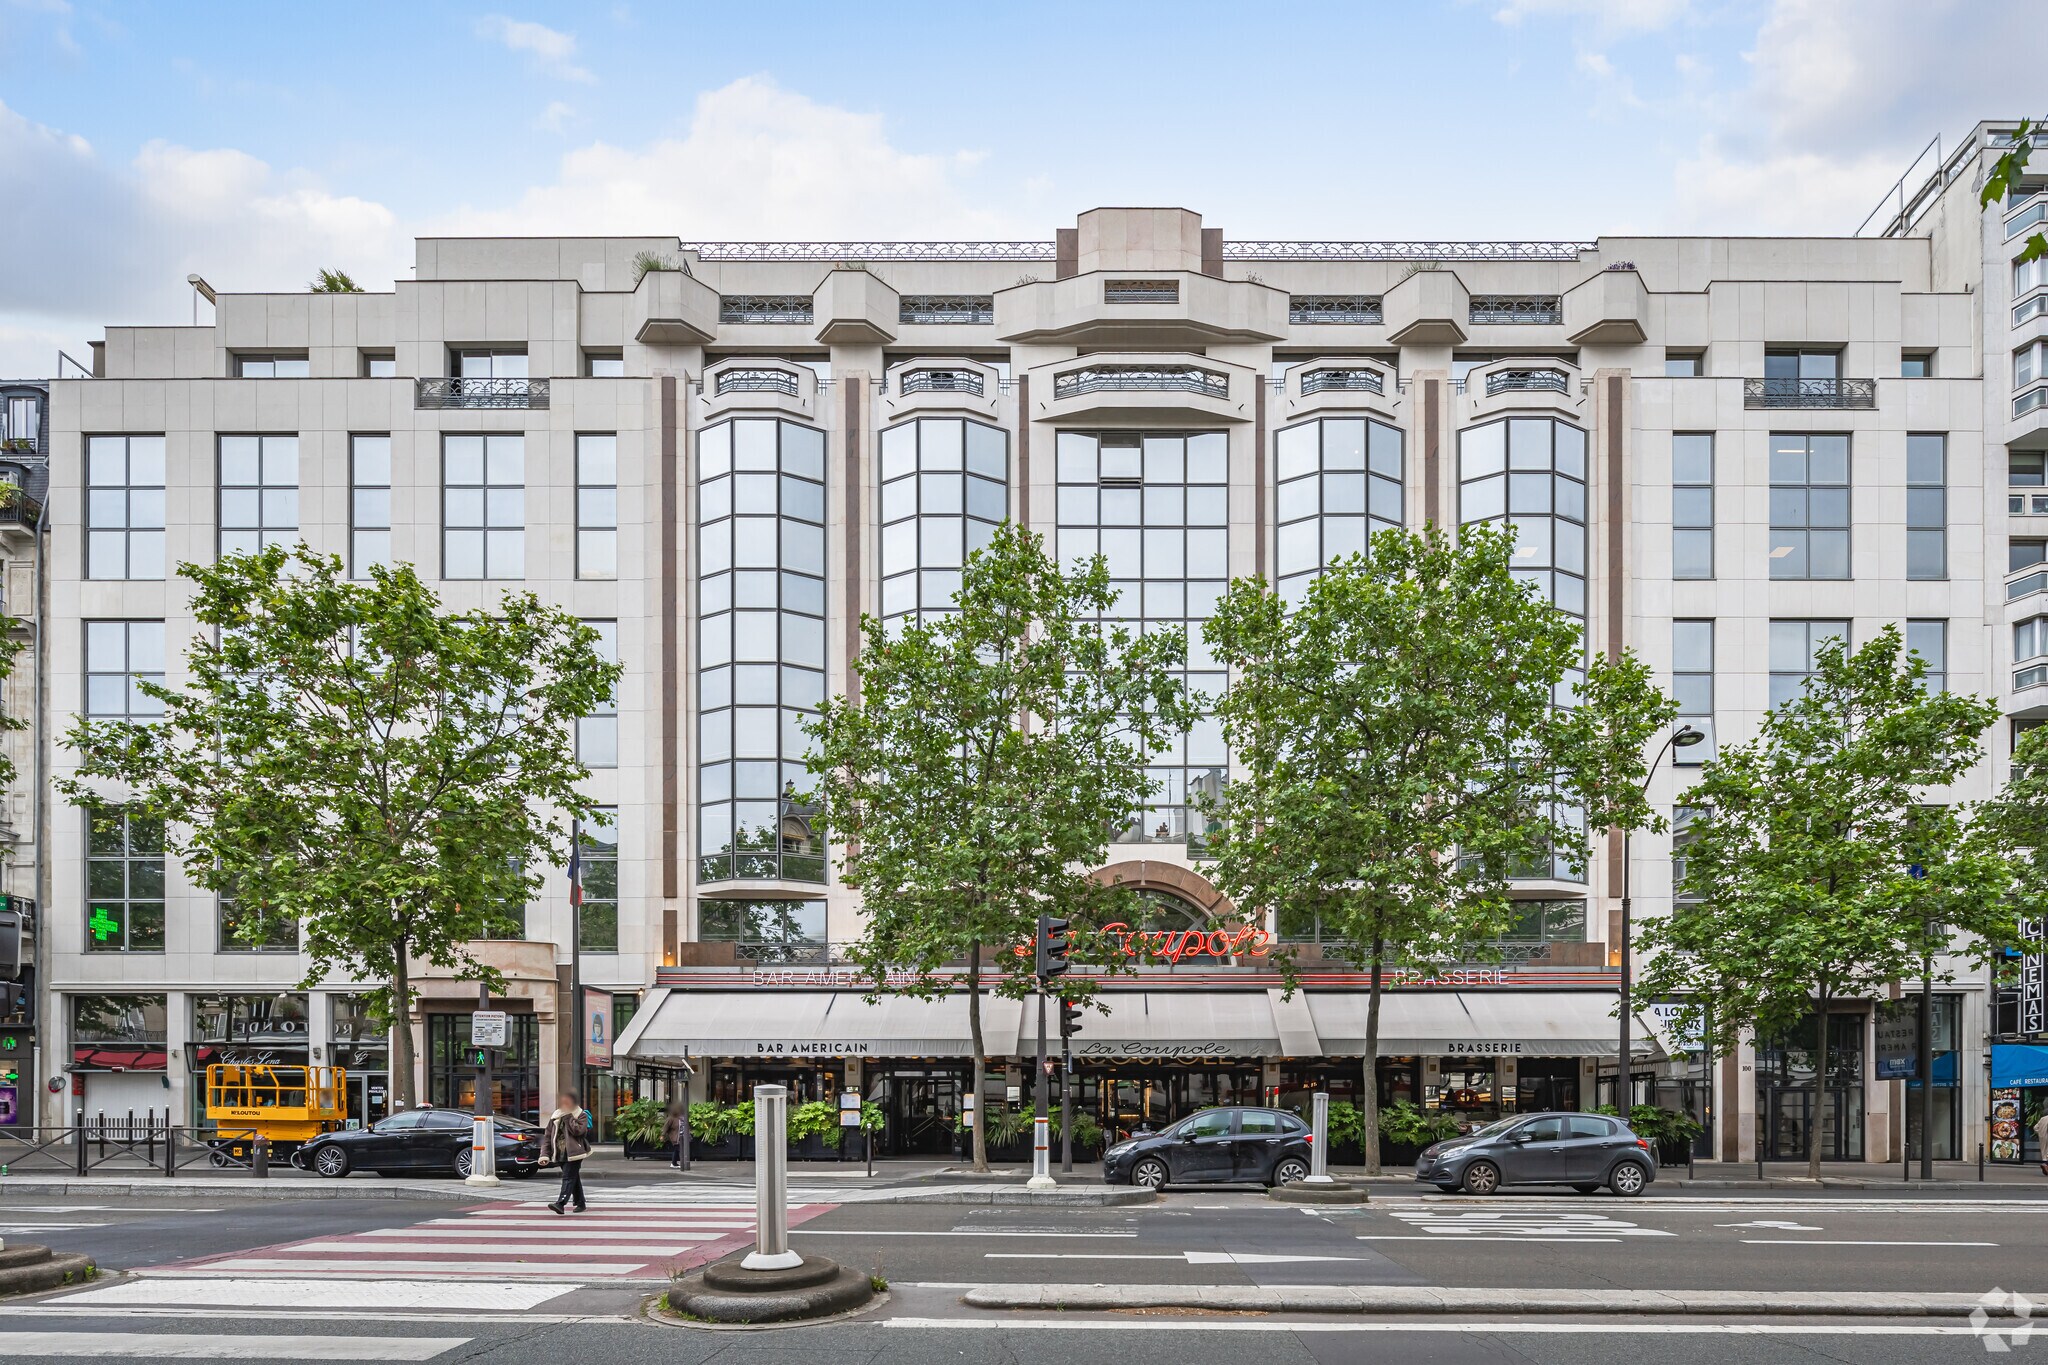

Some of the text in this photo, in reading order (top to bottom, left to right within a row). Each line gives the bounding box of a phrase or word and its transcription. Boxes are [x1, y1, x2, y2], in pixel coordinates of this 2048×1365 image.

[753, 970, 794, 986] BAR
[757, 1043, 868, 1052] BAR AMERICAIN
[1079, 1042, 1231, 1058] La Coupole
[1448, 1043, 1521, 1053] BRASSERIE
[1388, 1212, 1679, 1236] BUS
